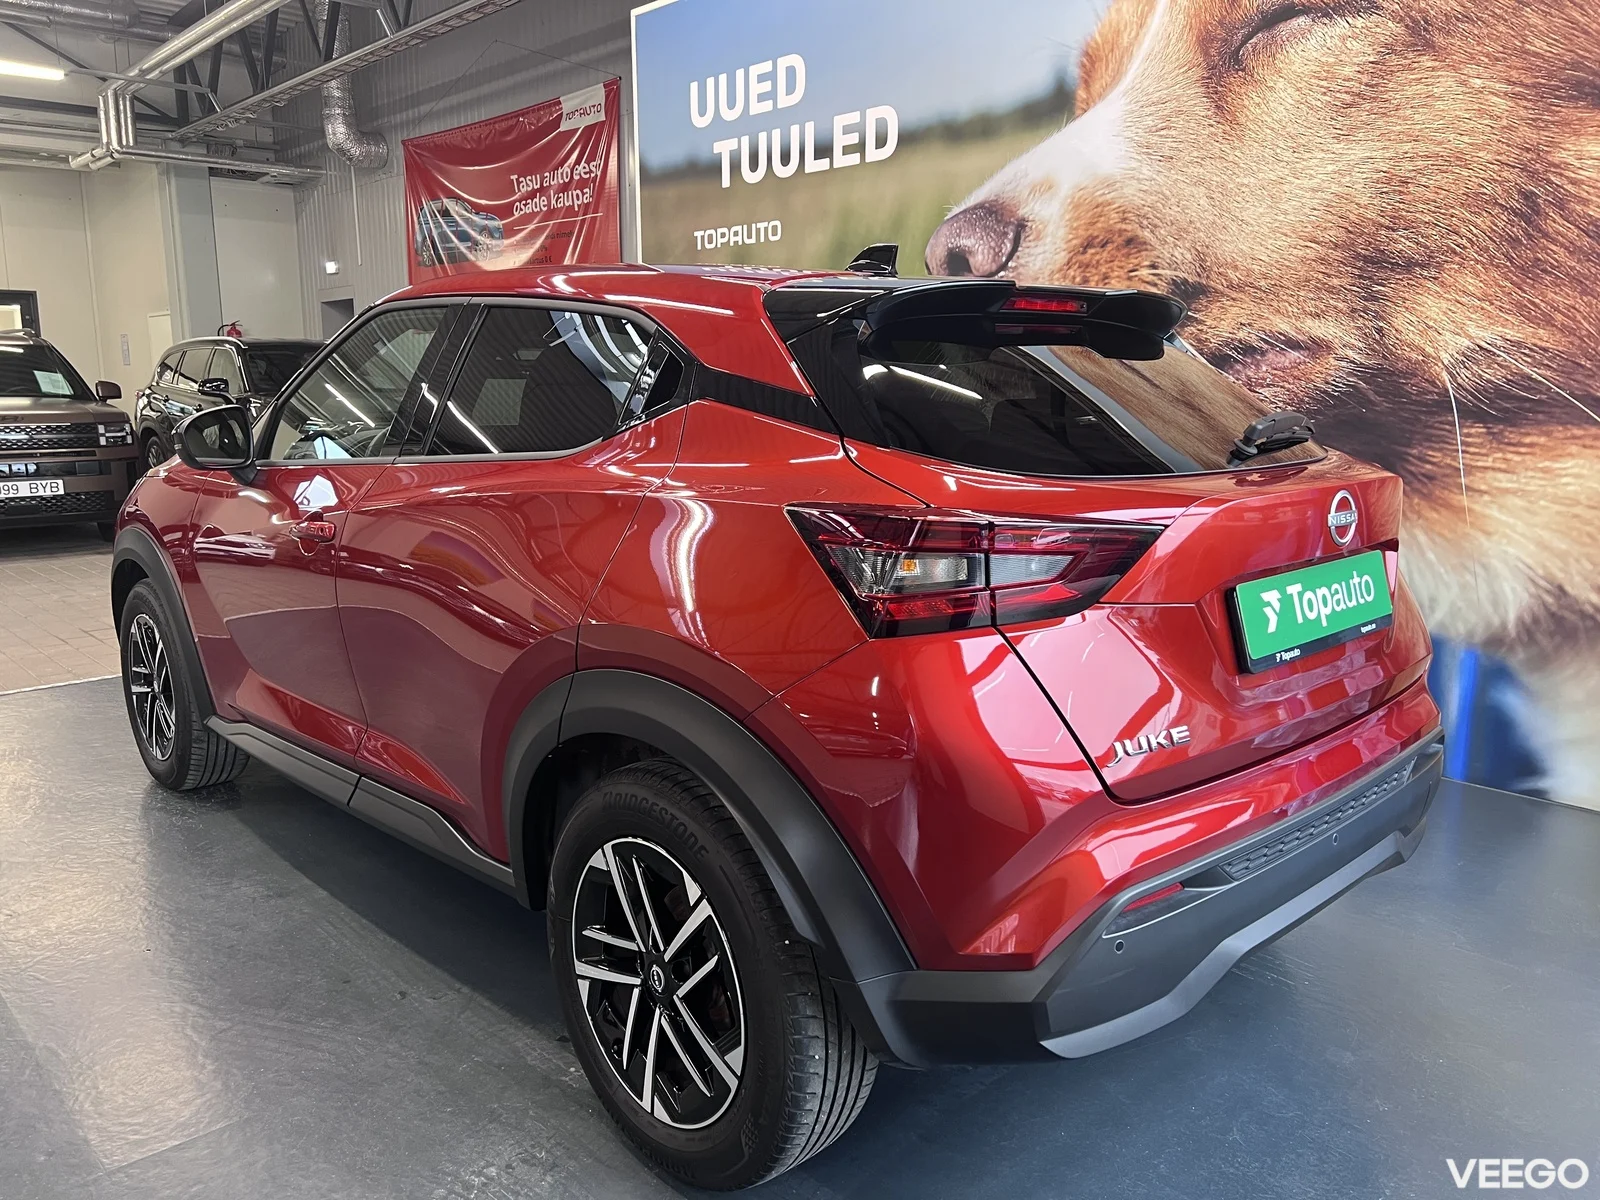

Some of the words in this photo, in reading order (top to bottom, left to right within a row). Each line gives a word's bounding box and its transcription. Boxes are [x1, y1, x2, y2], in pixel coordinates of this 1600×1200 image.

[690, 53, 806, 128] UUED
[565, 103, 602, 121] TOPAUTO
[713, 105, 899, 188] TUULED
[510, 174, 540, 193] Tasu
[543, 166, 571, 187] auto
[513, 192, 548, 216] osade
[550, 183, 593, 211] kaupa!
[694, 220, 782, 250] TOPAUTO
[0, 484, 19, 495] 99
[29, 482, 59, 494] BYB
[1330, 512, 1357, 525] NISSA
[1286, 571, 1375, 627] Topauto
[1281, 648, 1300, 661] Topauto
[1106, 725, 1191, 768] JUKE
